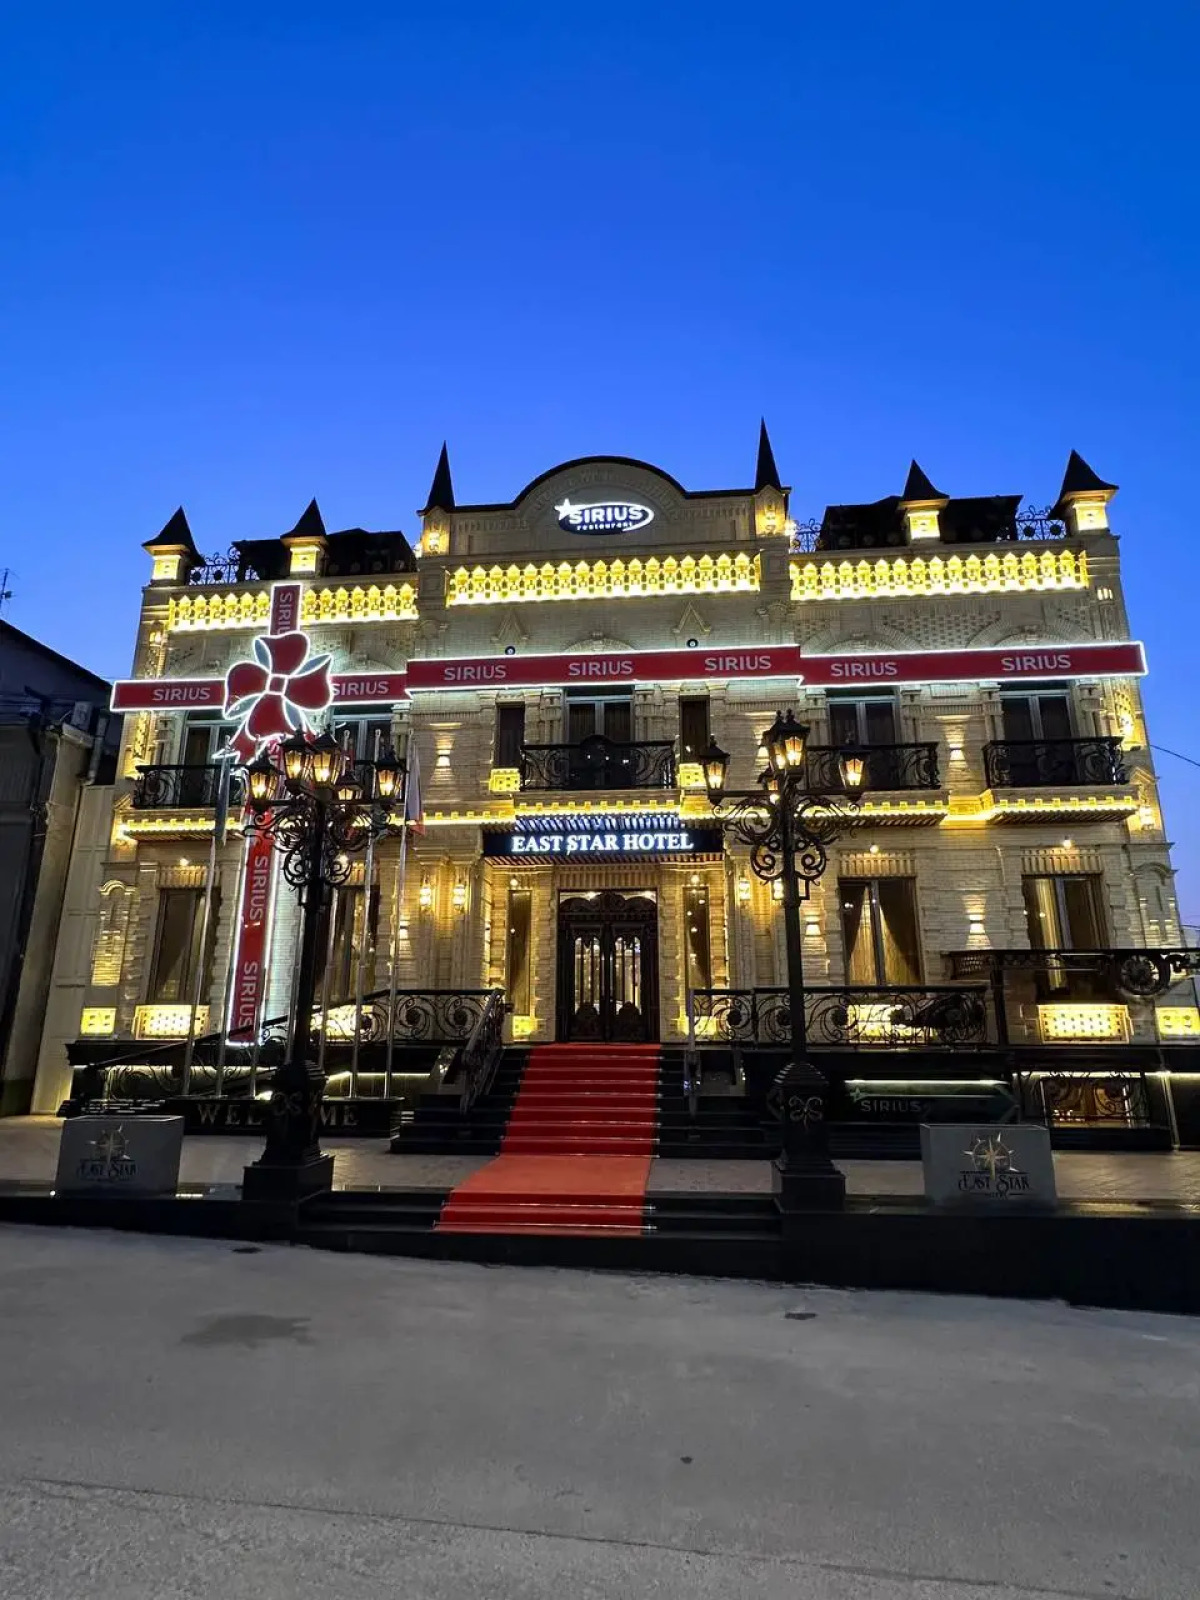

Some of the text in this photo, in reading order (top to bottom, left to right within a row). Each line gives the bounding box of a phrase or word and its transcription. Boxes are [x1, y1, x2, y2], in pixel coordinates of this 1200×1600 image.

[568, 506, 643, 524] SIRIUS
[277, 592, 292, 636] SIRIU
[568, 660, 634, 676] SIRIUS
[704, 655, 772, 671] SIRIUS
[830, 662, 898, 677] SIRIUS
[1001, 654, 1072, 671] SIRIUS
[443, 665, 507, 681] SIRIUS
[152, 687, 211, 701] SIRIUS
[331, 680, 390, 696] SIRIUS
[511, 832, 694, 853] EAST STAR HOTEL
[249, 856, 269, 920] SIRIUS
[238, 962, 258, 1028] SIRIUS
[860, 1099, 922, 1113] SIRIUS
[197, 1103, 360, 1126] WELME
